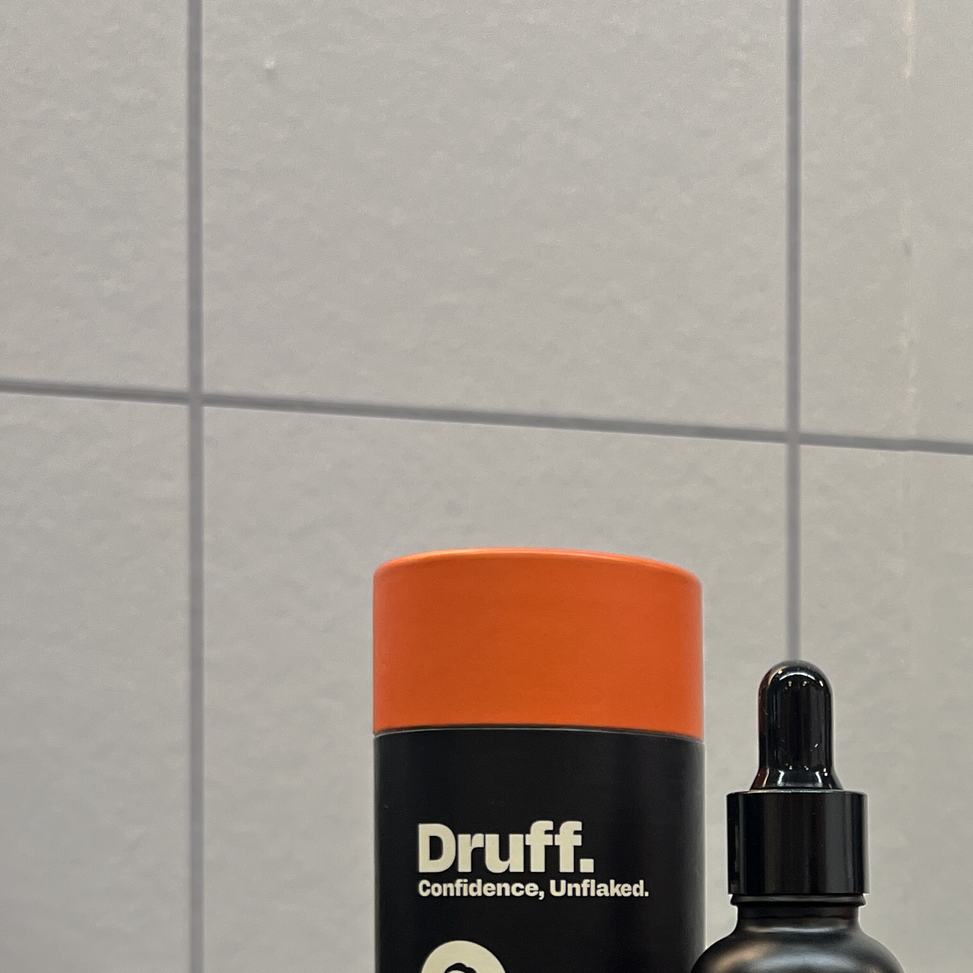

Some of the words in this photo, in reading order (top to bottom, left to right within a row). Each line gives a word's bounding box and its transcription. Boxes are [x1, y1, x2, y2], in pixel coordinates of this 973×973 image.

[418, 820, 594, 873] Druff.
[418, 879, 545, 900] Confidence,
[550, 879, 649, 897] Unflaked.
